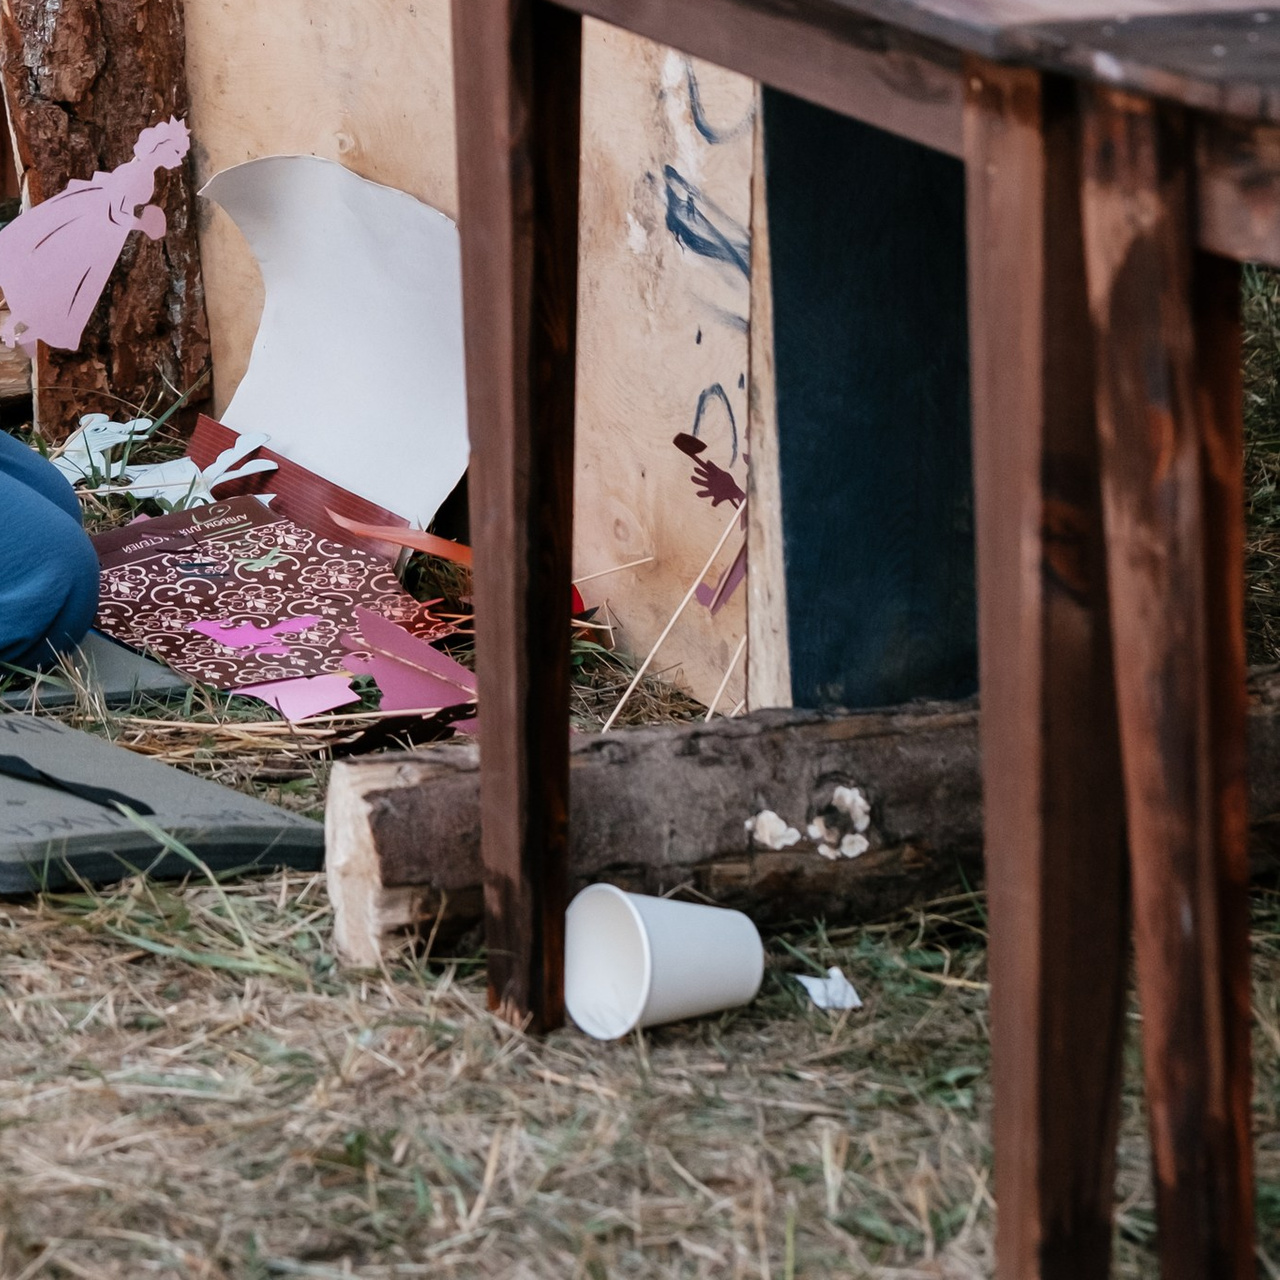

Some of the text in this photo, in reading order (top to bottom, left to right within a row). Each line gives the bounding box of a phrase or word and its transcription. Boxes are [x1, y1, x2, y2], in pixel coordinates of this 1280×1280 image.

[122, 513, 248, 554] АЛЬБОМ ДЛЯ СТЕЛЕЙ
